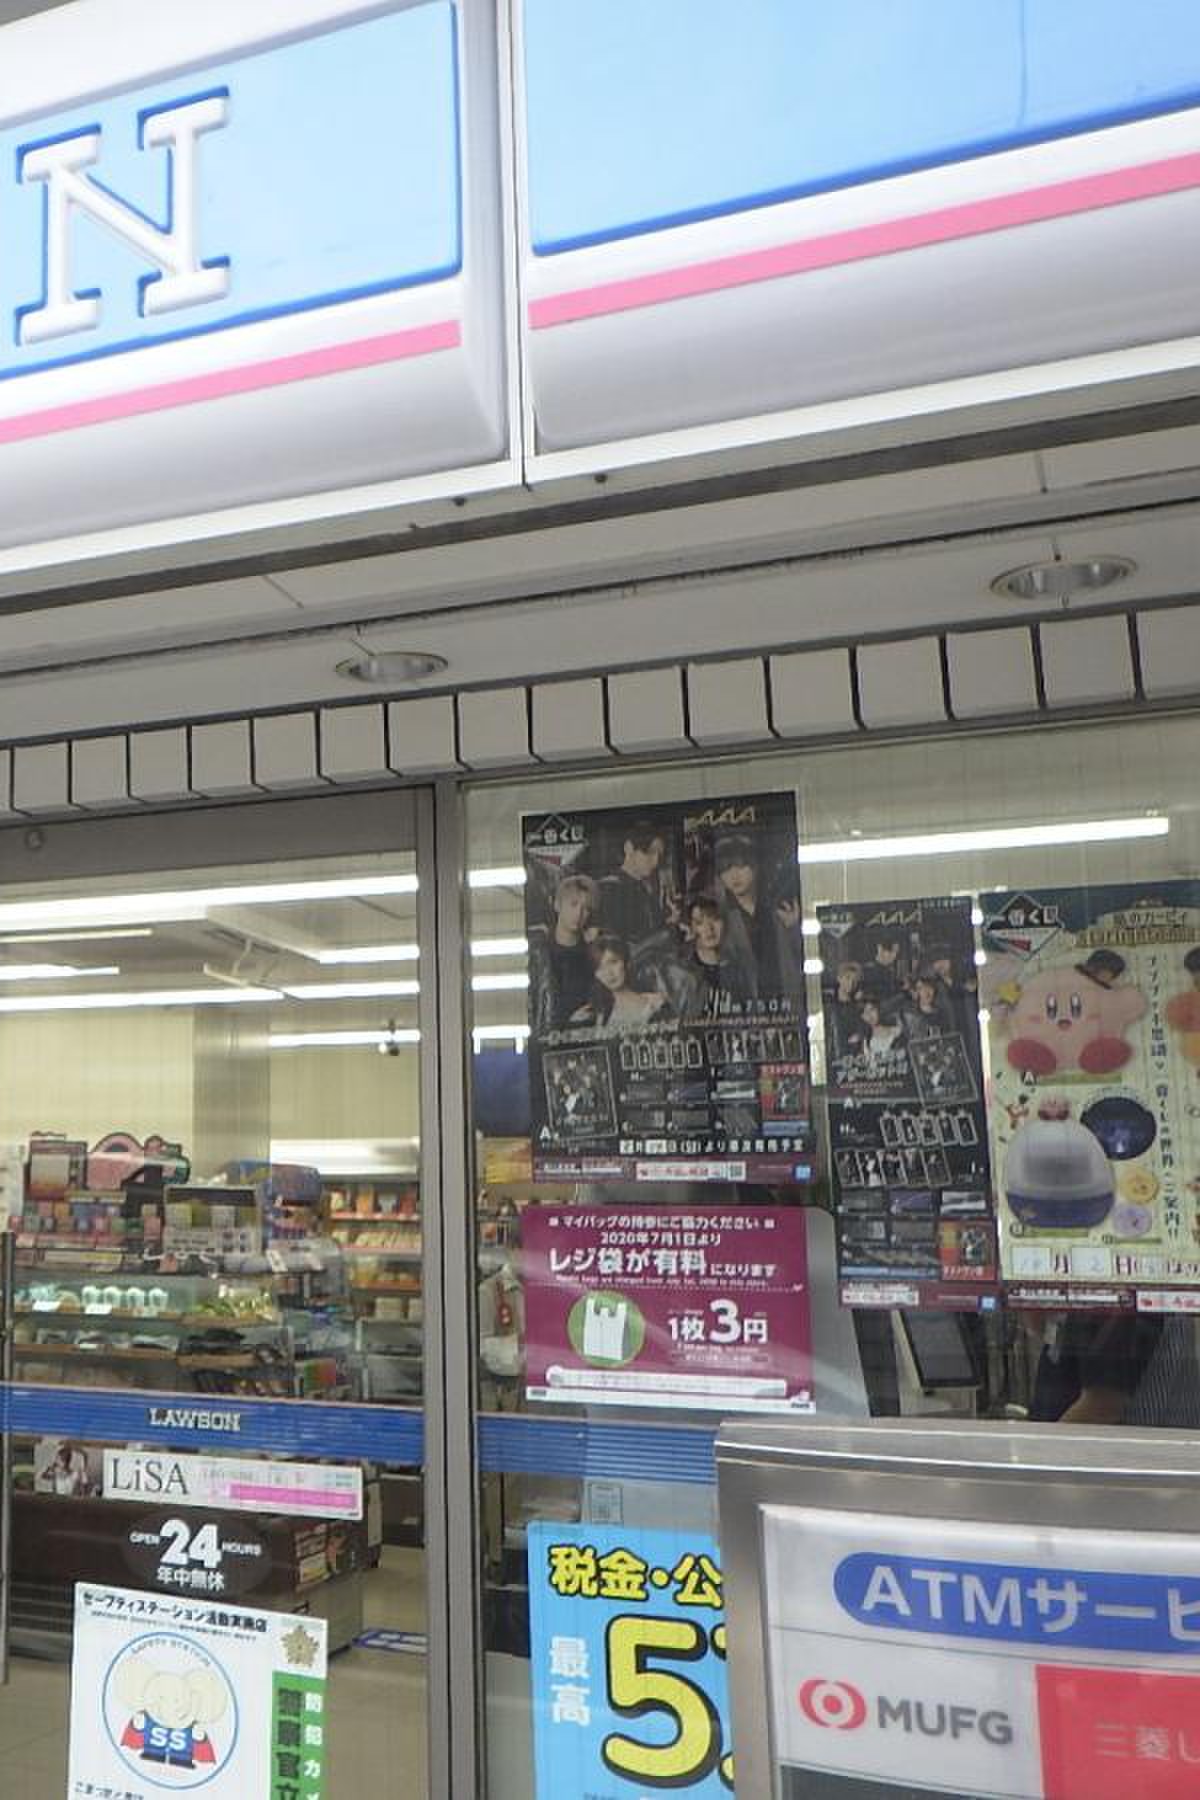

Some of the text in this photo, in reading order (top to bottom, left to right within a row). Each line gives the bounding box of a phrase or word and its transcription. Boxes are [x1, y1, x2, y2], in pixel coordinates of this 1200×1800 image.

[600, 1231, 722, 1247] 2020年7月1日より
[149, 1407, 241, 1432] LAWSON
[111, 1456, 191, 1495] LiSA
[129, 1518, 262, 1568] OPEN 24 HOURS
[156, 1565, 226, 1592] 年中無休
[548, 1544, 723, 1610] 税金・公
[549, 1635, 592, 1727] 最高
[602, 1613, 734, 1792] 5
[150, 1727, 188, 1751] SS
[877, 1693, 1014, 1748] MUFG
